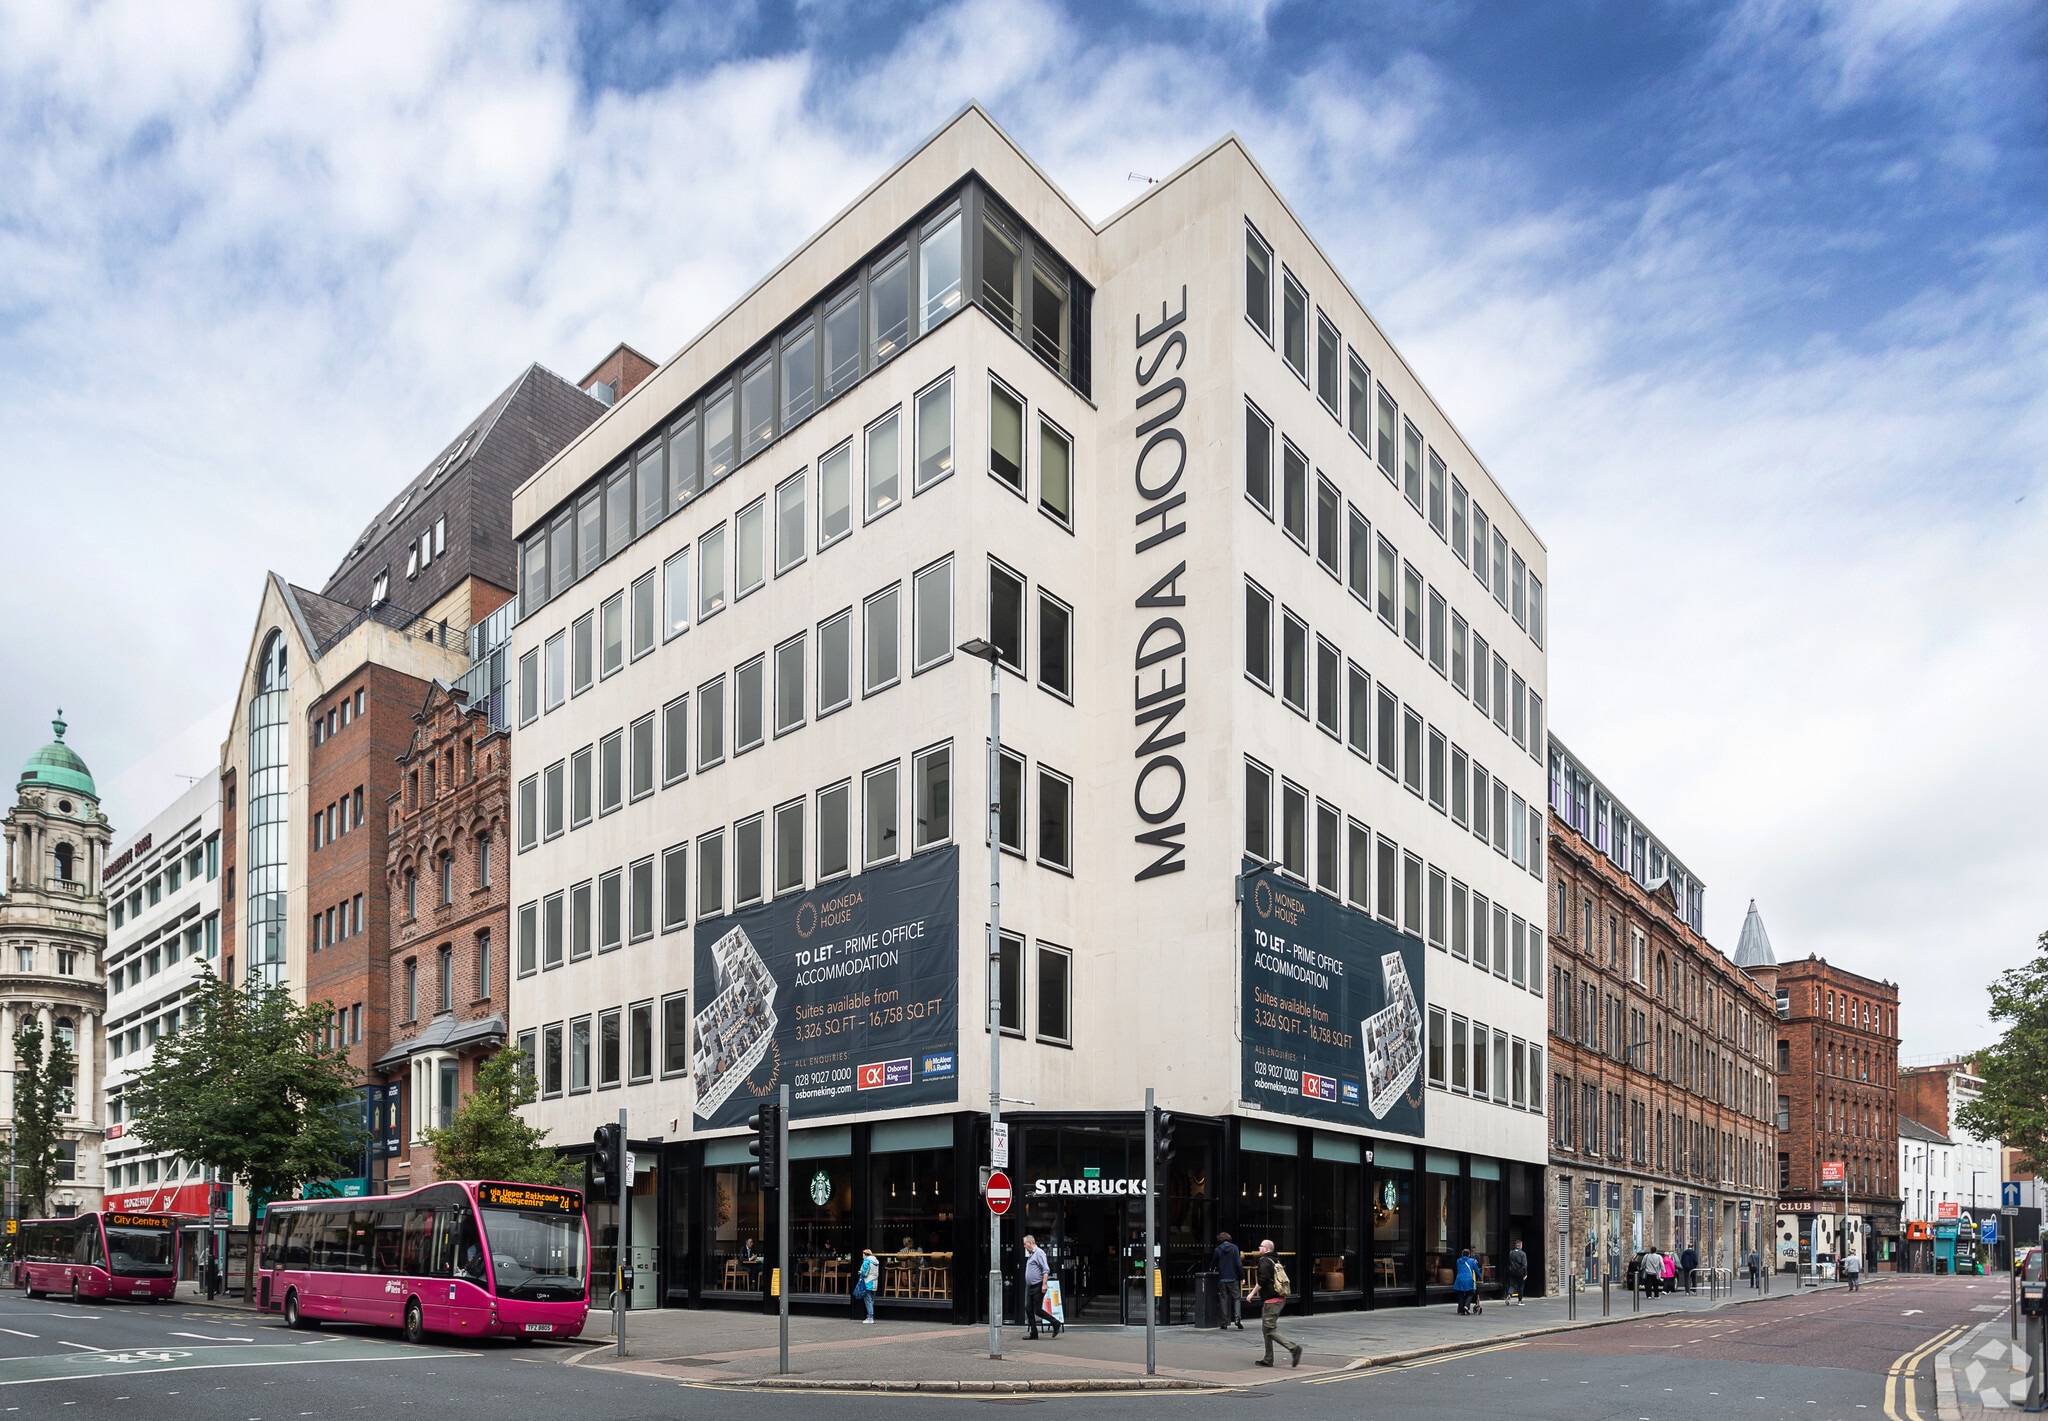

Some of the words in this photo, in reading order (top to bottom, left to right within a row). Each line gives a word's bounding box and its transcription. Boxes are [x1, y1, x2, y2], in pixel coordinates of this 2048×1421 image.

[1135, 284, 1187, 555] HOUSE
[1135, 559, 1186, 882] MONEDA
[821, 892, 863, 914] MONEDA
[1274, 892, 1306, 915] MONEDA
[820, 909, 851, 928] HOUSE
[1274, 906, 1298, 926] HOUSE
[795, 950, 810, 967] TO
[814, 944, 834, 963] LET
[845, 932, 878, 956] PRIME
[882, 920, 925, 946] OFFICE
[1254, 928, 1268, 948] TO
[1270, 934, 1286, 954] LET
[1293, 944, 1316, 966] PRIME
[1317, 953, 1343, 976] OFFICE
[794, 950, 898, 988] ACCOMMODATION
[1254, 952, 1328, 990] ACCOMMODATION
[795, 1004, 824, 1021] Suites
[826, 992, 871, 1014] available
[874, 988, 899, 1004] from
[1254, 986, 1278, 1008] Suites
[1280, 998, 1311, 1018] available
[1312, 1004, 1329, 1023] from
[796, 1024, 822, 1042] 3,326
[825, 1018, 840, 1036] SQ
[842, 1015, 856, 1032] FT
[869, 1006, 903, 1028] 16,758
[906, 1002, 924, 1021] SQ
[927, 998, 942, 1017] FT
[1254, 1008, 1276, 1028] 3,326
[1278, 1014, 1290, 1034] SQ
[1292, 1018, 1301, 1035] FT
[1310, 1022, 1330, 1044] 16,758
[1332, 1030, 1343, 1047] SQ
[1344, 1034, 1353, 1049] FT
[794, 1059, 807, 1068] ALL
[810, 1052, 849, 1066] ENQUIRIES:
[1254, 1045, 1265, 1055] ALL
[794, 1074, 808, 1087] 028
[812, 1070, 830, 1085] 9027
[832, 1067, 852, 1082] 0000
[886, 1065, 908, 1073] Osborne
[886, 1074, 898, 1082] King
[1254, 1061, 1267, 1075] 028
[1268, 1064, 1282, 1078] 9027
[1284, 1068, 1298, 1082] 0000
[794, 1084, 852, 1100] osborneking.com
[1254, 1078, 1298, 1096] osborneking.com
[490, 1188, 501, 1196] via
[502, 1188, 524, 1199] Upper
[560, 1196, 569, 1209] 2d
[499, 1195, 544, 1207] Abbeycentre
[1778, 1202, 1812, 1210] CLUB
[114, 1215, 130, 1226] City
[132, 1216, 160, 1227] Centre
